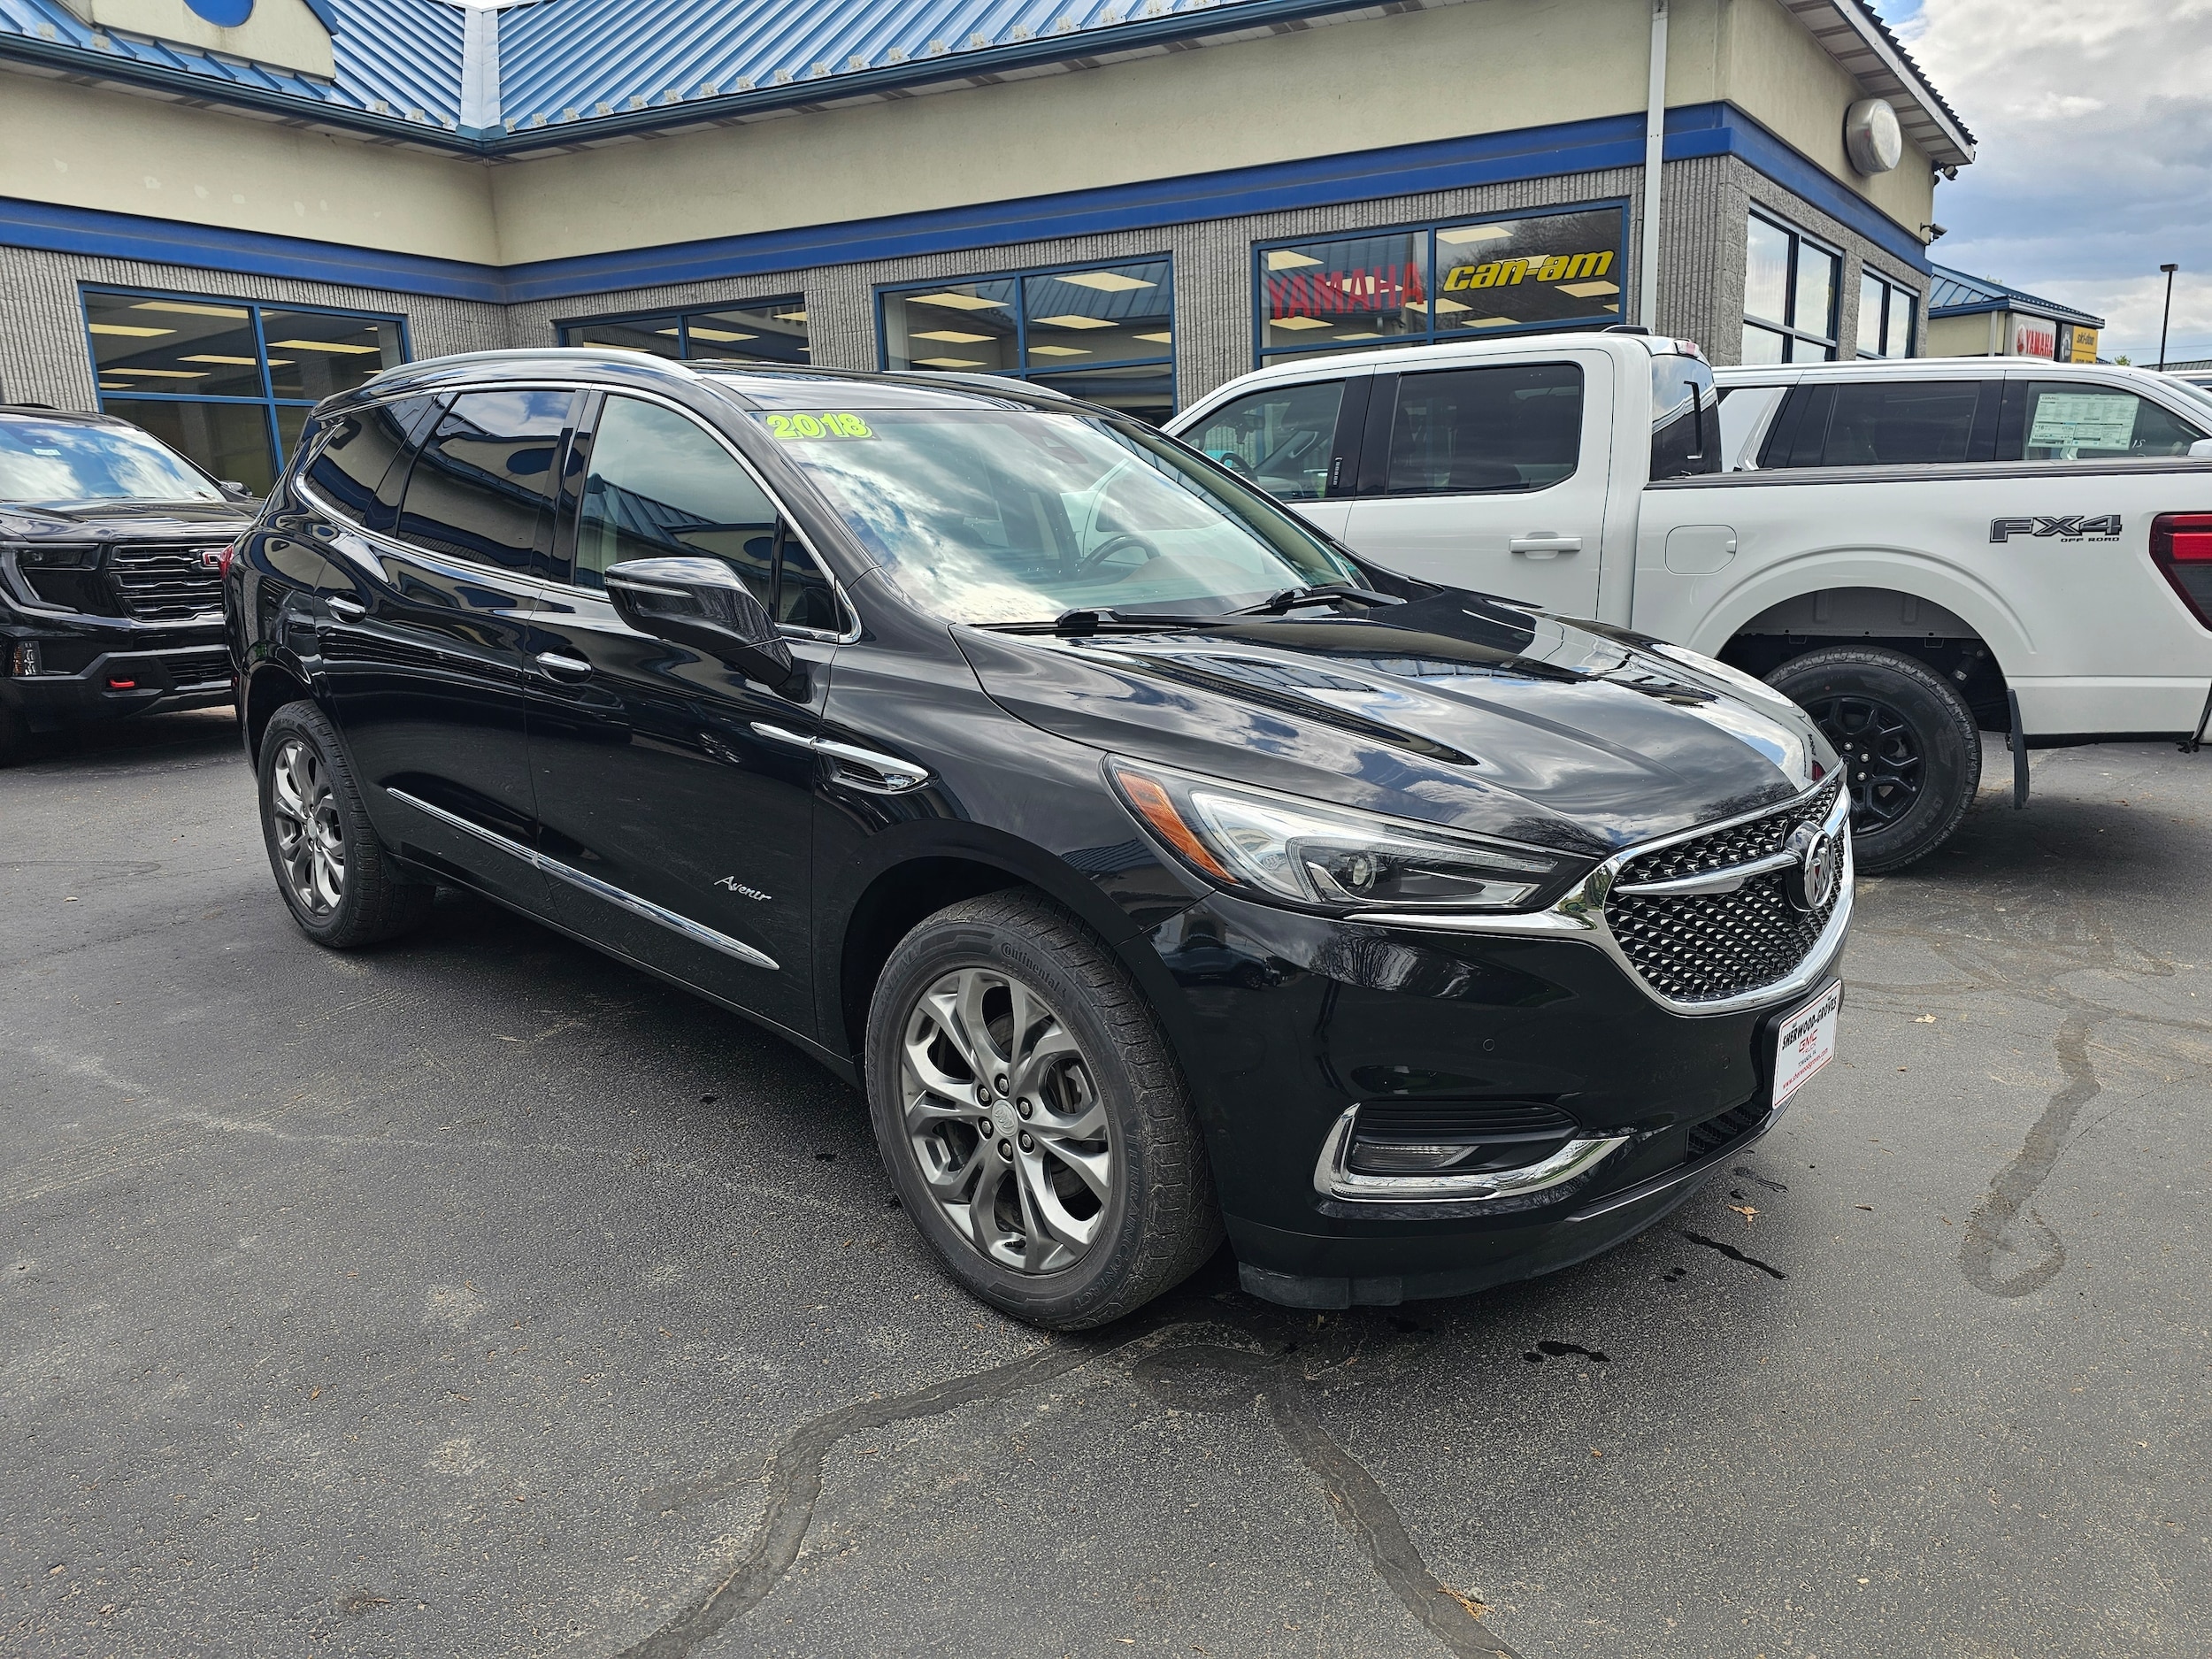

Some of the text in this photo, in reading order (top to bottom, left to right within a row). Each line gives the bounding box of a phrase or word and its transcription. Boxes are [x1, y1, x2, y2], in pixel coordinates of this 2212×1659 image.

[1443, 250, 1615, 293] can-am
[1268, 261, 1425, 320] YAMAHA
[2026, 328, 2053, 358] YAMAHA
[2076, 332, 2094, 346] ski-doo
[766, 412, 873, 439] 2018
[1990, 514, 2123, 543] FX4
[713, 875, 772, 901] Avenir
[1001, 942, 1061, 992] Continental
[1781, 995, 1838, 1051] SHERWOOD-GROVES
[1798, 1028, 1818, 1053] GMC
